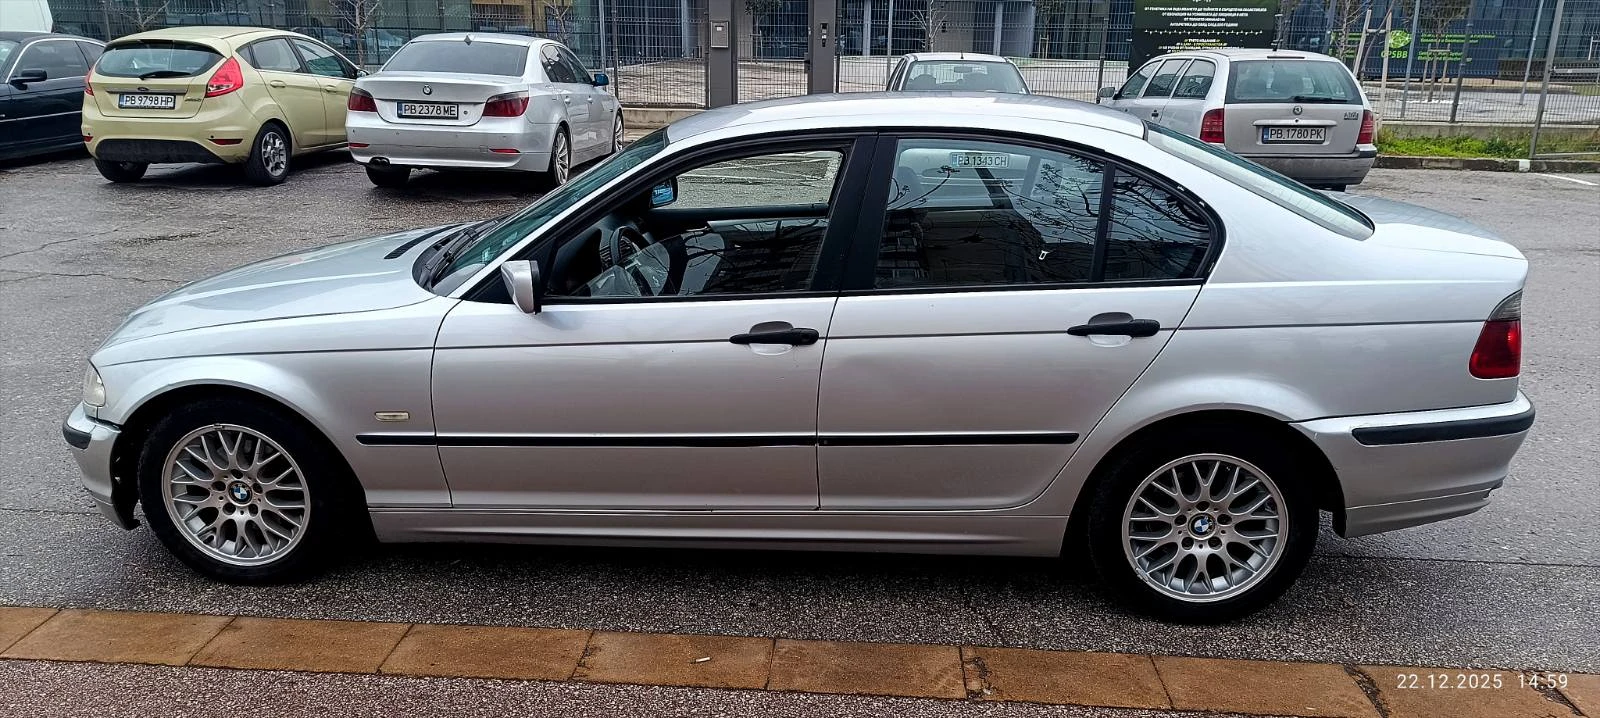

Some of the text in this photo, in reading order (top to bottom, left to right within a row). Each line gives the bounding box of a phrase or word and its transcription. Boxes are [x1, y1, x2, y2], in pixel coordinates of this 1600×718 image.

[125, 95, 136, 105] PB
[137, 95, 159, 105] 9798
[160, 96, 173, 106] HP
[404, 104, 456, 116] PB 2378 ME
[1269, 128, 1323, 139] PB 1780 PK
[972, 156, 993, 166] 1343
[994, 156, 1007, 166] CH
